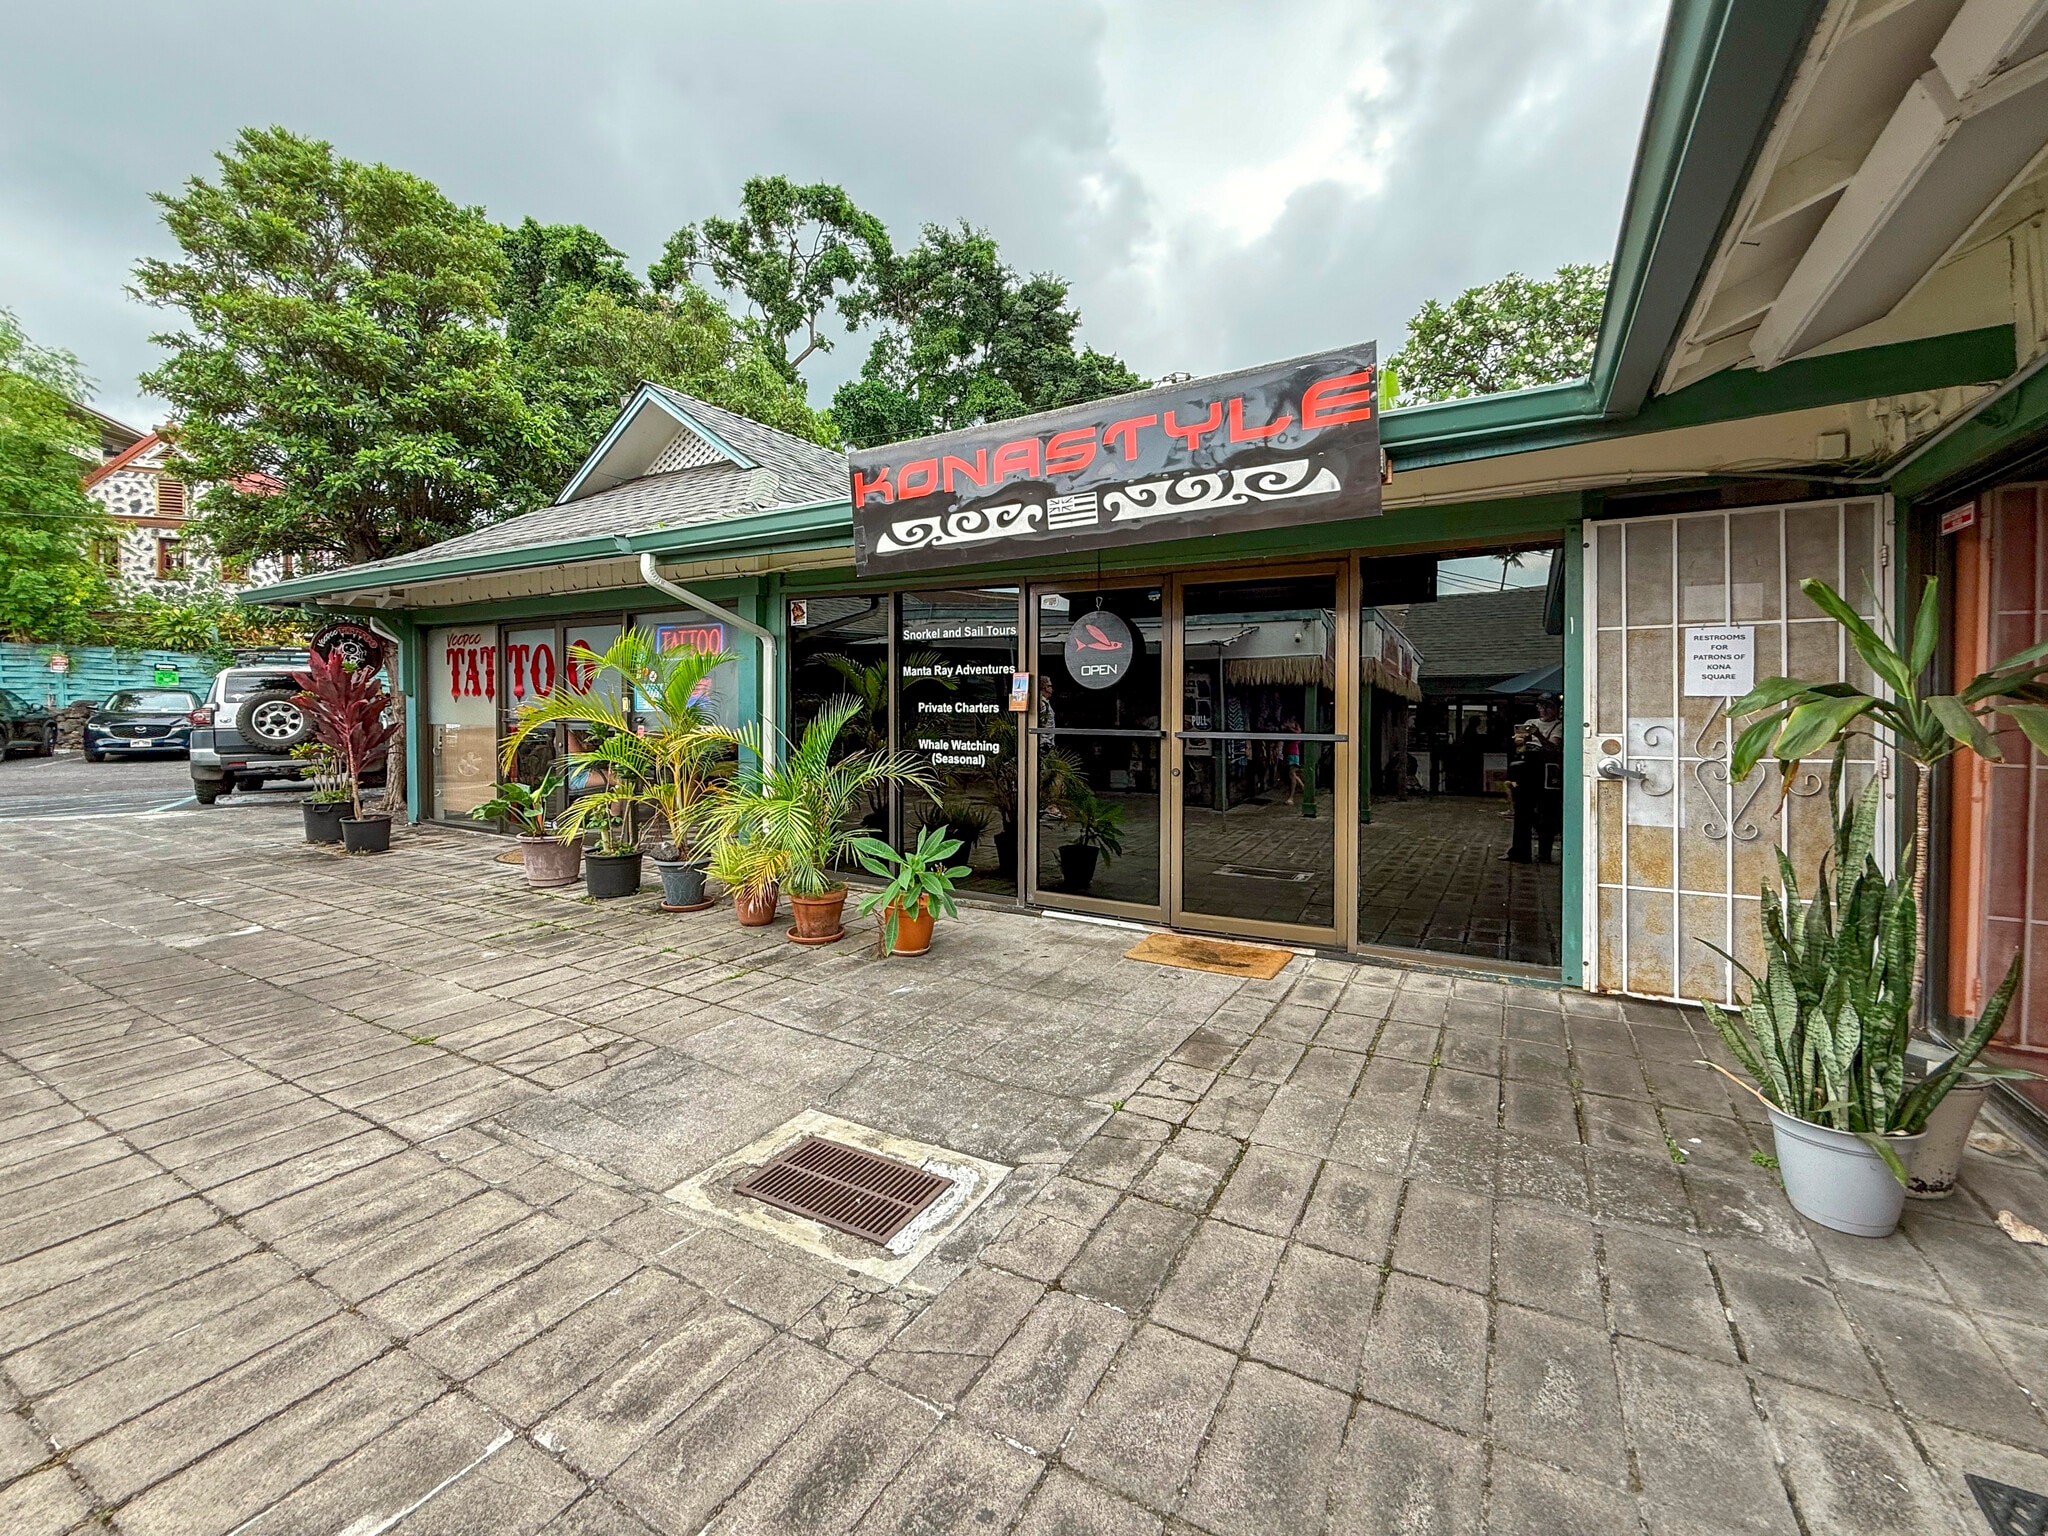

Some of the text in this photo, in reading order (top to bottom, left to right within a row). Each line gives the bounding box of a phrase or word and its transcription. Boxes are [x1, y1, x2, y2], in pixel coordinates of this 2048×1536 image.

[853, 368, 1372, 507] KONASTYLE
[903, 625, 1016, 640] Snorkel and Sail Tours
[661, 628, 720, 656] TATTOO
[903, 664, 1016, 678] Manta Ray Adventures
[1081, 663, 1117, 676] OPEN
[918, 702, 952, 713] Private
[955, 702, 1000, 713] Charters
[1191, 715, 1208, 726] PULL
[918, 739, 1000, 753] Whale Watching
[931, 753, 986, 767] (Seasonal)
